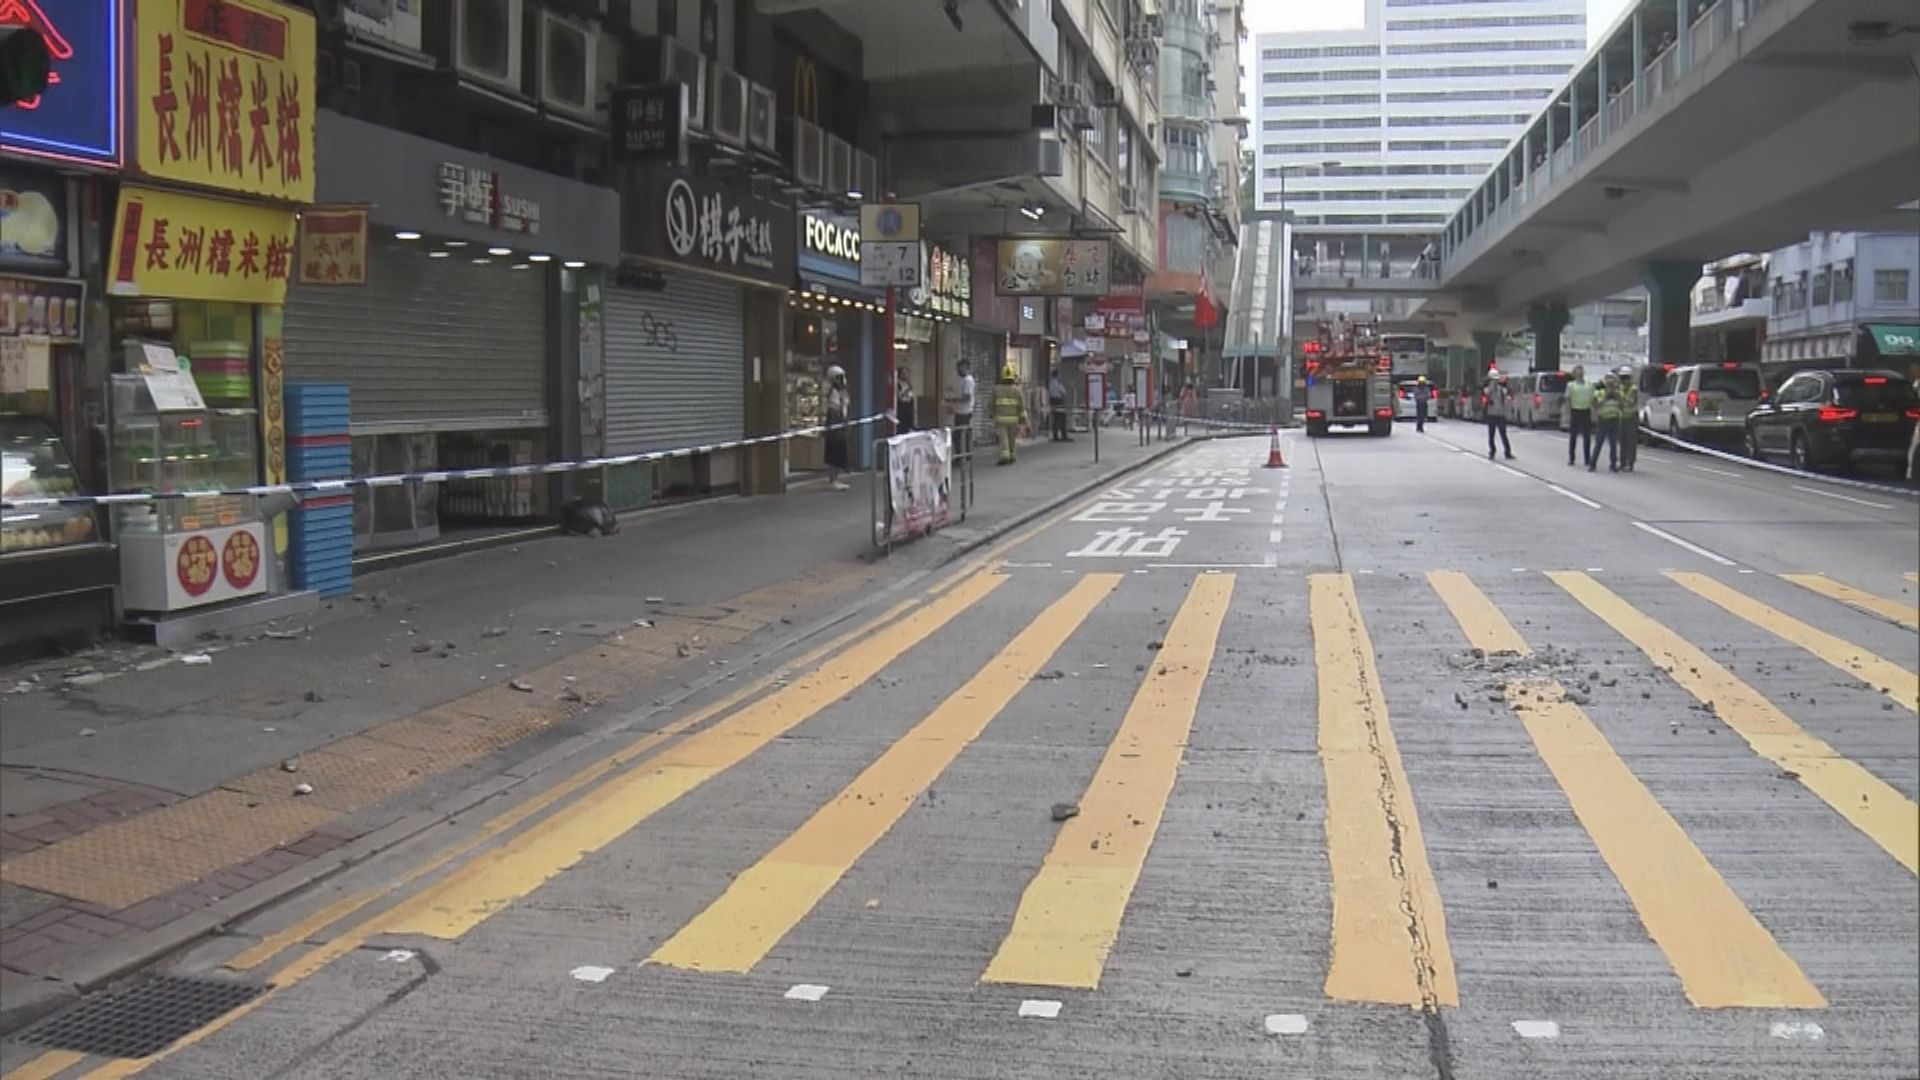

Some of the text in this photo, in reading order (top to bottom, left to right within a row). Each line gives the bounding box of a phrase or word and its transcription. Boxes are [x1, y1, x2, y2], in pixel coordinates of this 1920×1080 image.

[152, 33, 302, 189] 長洲糯米糍
[503, 194, 540, 221] SUSHI
[144, 219, 293, 281] 長洲糯米糍
[897, 246, 908, 260] 7
[898, 267, 915, 281] 12
[1069, 500, 1252, 521] 巴士
[1066, 525, 1189, 557] 站
